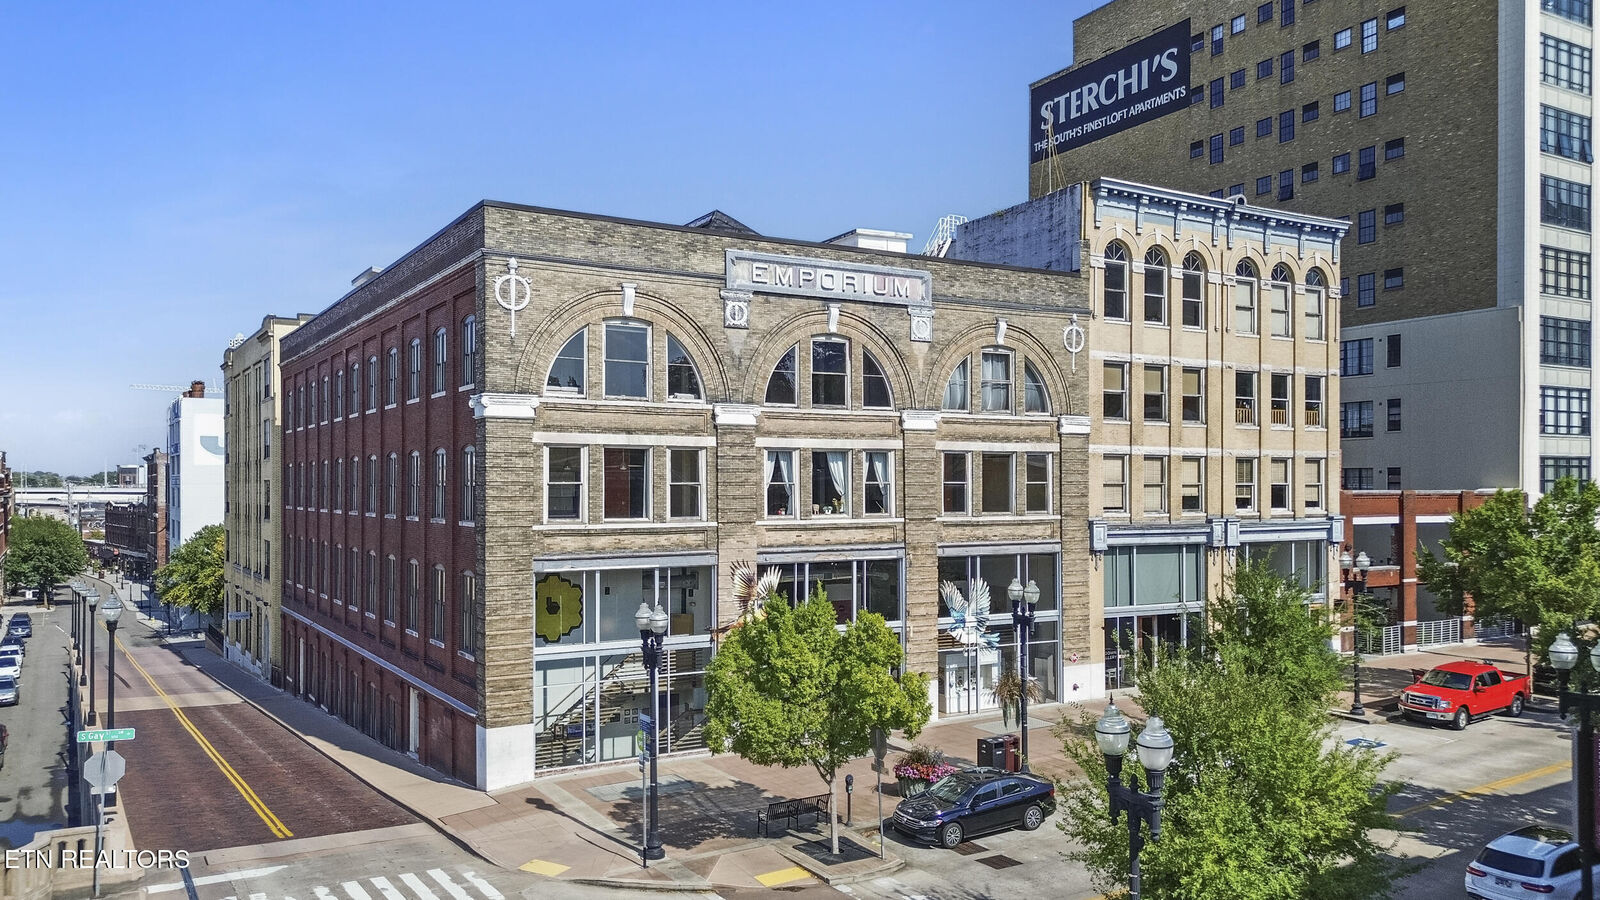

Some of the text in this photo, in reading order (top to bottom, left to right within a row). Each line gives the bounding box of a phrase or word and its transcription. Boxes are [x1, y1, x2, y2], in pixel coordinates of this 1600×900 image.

[1040, 48, 1178, 130] STERCHI'S
[1033, 85, 1187, 152] THE SOUTH'S FINEST LOFT APARTMENTS
[752, 263, 910, 298] EMPORIUM
[88, 732, 105, 741] Gay
